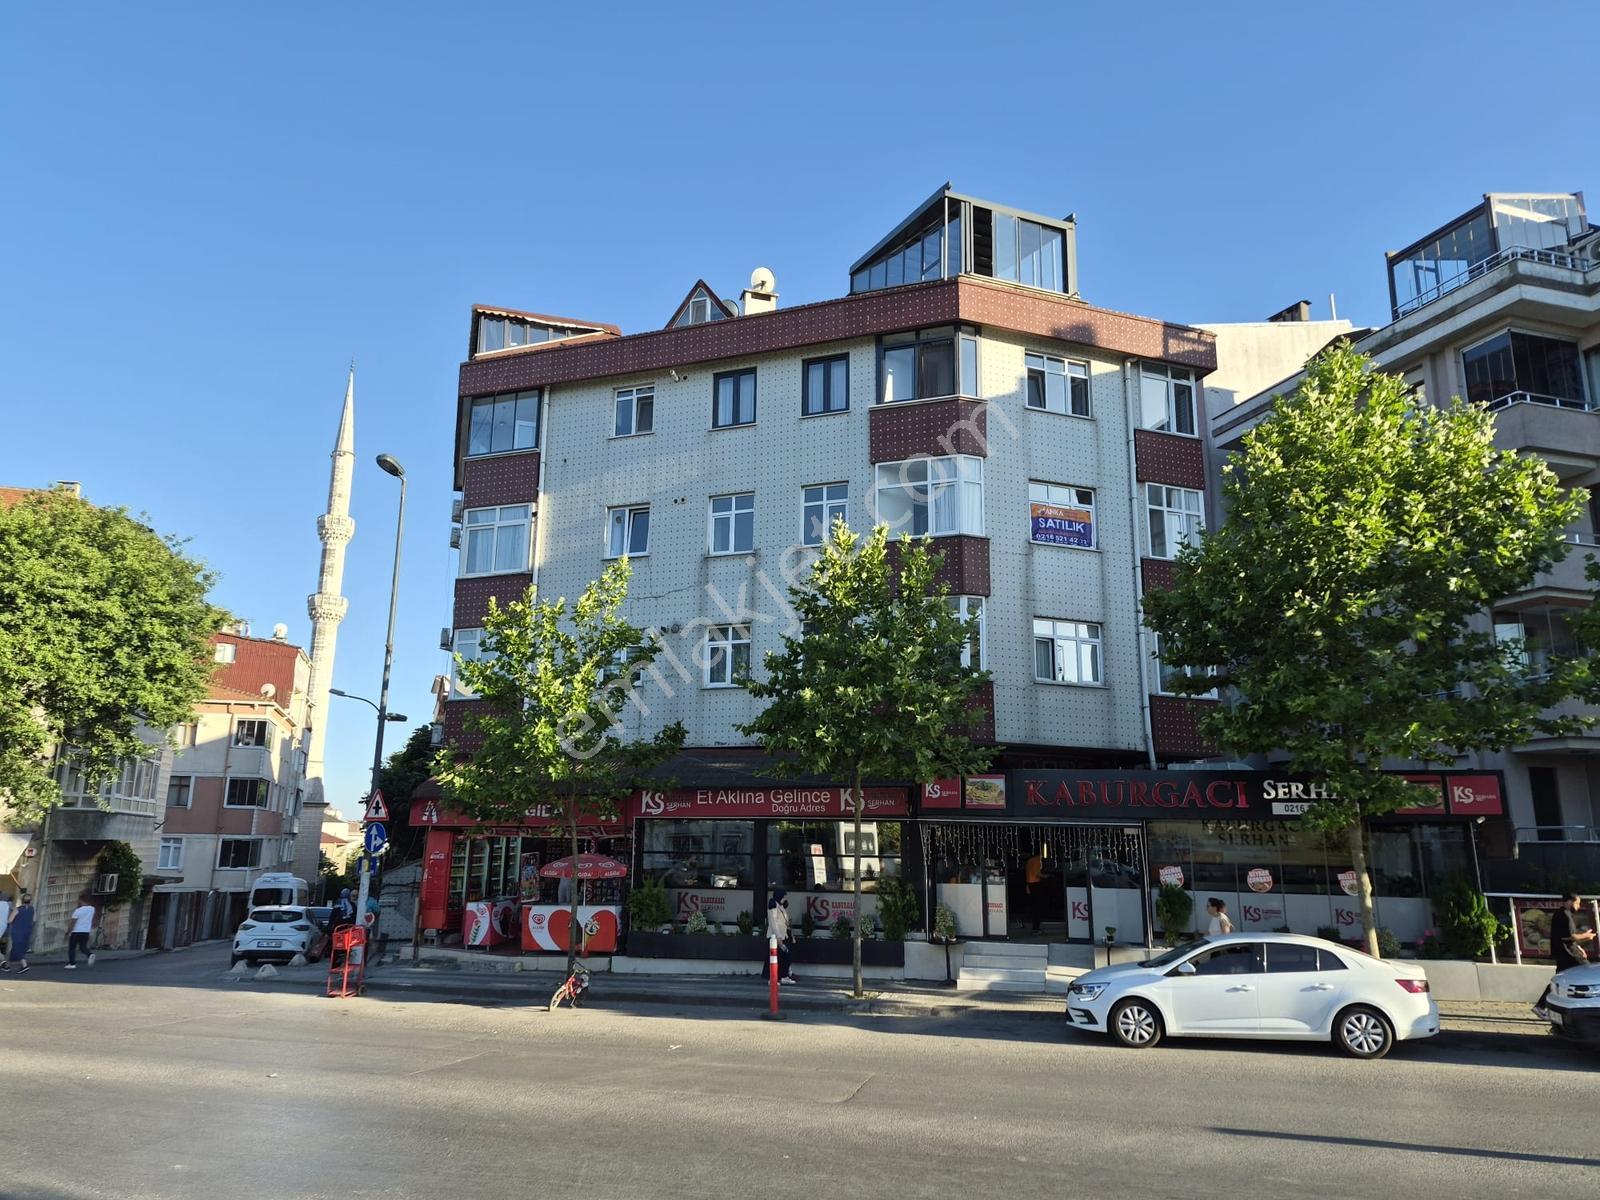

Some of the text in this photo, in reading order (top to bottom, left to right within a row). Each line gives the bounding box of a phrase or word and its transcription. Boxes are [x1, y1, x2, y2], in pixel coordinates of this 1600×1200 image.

[1038, 518, 1085, 533] SATILIK
[697, 790, 713, 804] Et
[716, 790, 765, 804] Aklına
[770, 789, 830, 804] Gelince
[926, 783, 941, 798] KS
[1024, 780, 1250, 808] KABURGACI
[1453, 786, 1474, 803] KS
[641, 790, 664, 815] KS
[772, 803, 826, 814] Doğru Adres
[1284, 804, 1305, 812] 0216
[677, 892, 699, 913] KS
[806, 896, 829, 921] KS
[1244, 906, 1261, 922] KS
[1336, 909, 1355, 925] KS
